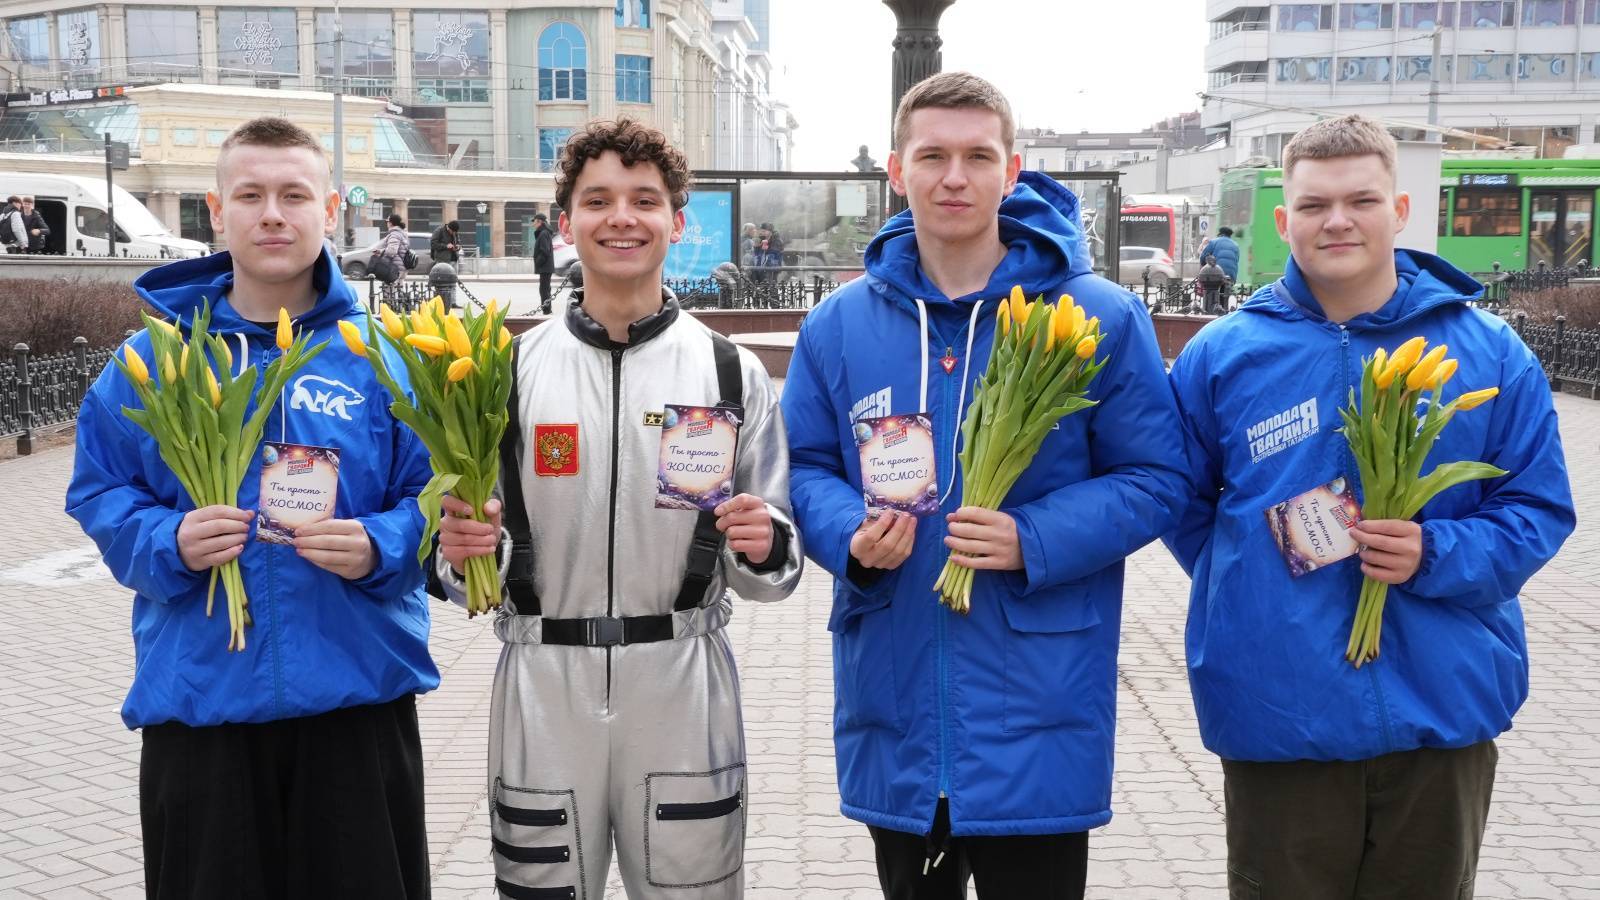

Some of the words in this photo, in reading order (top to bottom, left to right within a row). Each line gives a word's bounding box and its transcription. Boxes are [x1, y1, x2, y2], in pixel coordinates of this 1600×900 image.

[1246, 397, 1319, 442] МОЛОДАЯ
[669, 445, 685, 455] Ты
[686, 449, 719, 460] просто
[666, 462, 726, 474] КОСМОС!
[869, 457, 886, 467] Ты
[887, 456, 919, 469] просто
[870, 469, 928, 484] КОСМОС!
[270, 481, 286, 492] Ты
[287, 486, 322, 496] просто
[267, 499, 327, 512] КОСМОС!
[1310, 498, 1320, 514] Ты
[1296, 503, 1326, 558] КОСМОС!
[1314, 515, 1334, 547] просто
